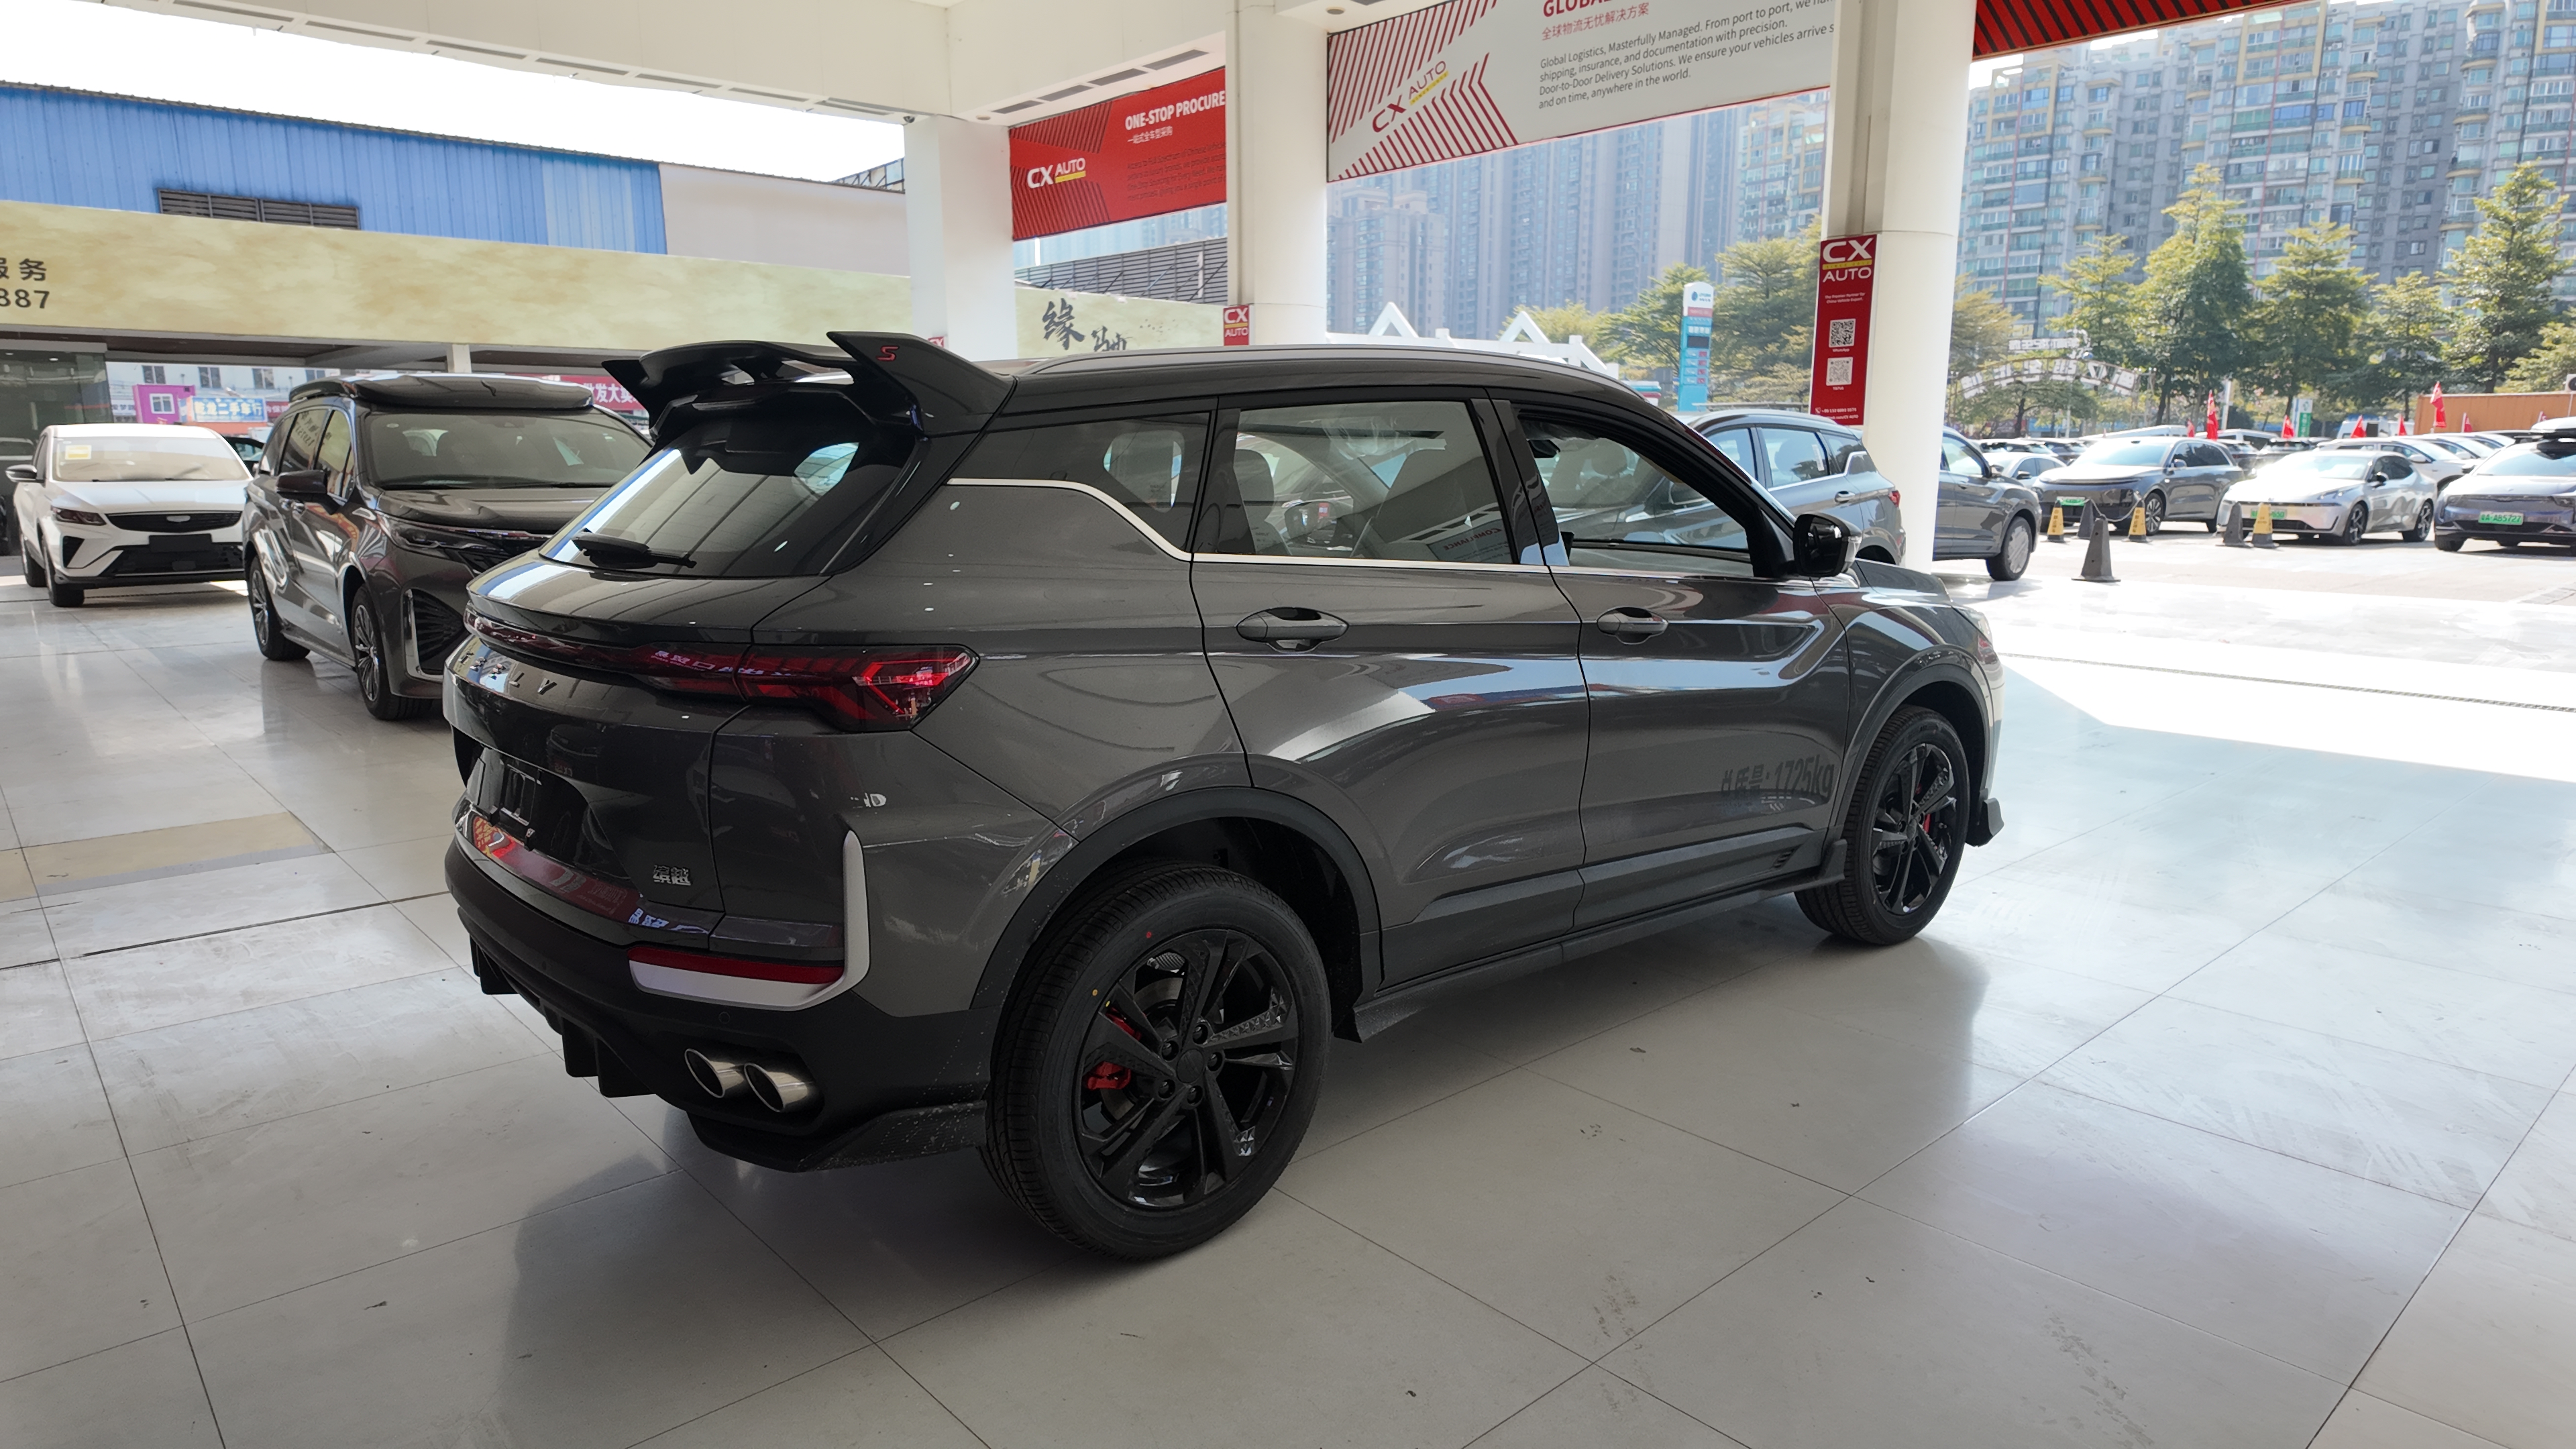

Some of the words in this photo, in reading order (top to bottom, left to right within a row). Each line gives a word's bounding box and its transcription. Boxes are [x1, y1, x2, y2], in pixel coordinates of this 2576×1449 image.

[1540, 53, 1566, 68] Global
[1568, 47, 1607, 62] Logistics,
[1609, 33, 1656, 52] Masterfully
[1658, 21, 1703, 41] Managed.
[1705, 17, 1730, 30] From
[1732, 11, 1753, 27] port
[1756, 9, 1766, 19] to
[1768, 2, 1793, 18] port,
[1796, 0, 1811, 9] we
[1542, 2, 1650, 41] 全球物流无忧解决方案
[1539, 76, 1593, 96] Door-to-Door
[1595, 68, 1629, 84] Delivery
[1631, 59, 1676, 76] Solutions.
[1678, 54, 1693, 65] We
[1695, 48, 1727, 62] ensure
[1729, 41, 1752, 58] your
[1753, 32, 1794, 49] vehicles
[1796, 25, 1827, 40] arrive
[1540, 67, 1577, 83] shipping,
[1578, 57, 1622, 73] insurance,
[1623, 50, 1641, 64] and
[1643, 36, 1713, 60] documentation
[1715, 28, 1737, 42] with
[1739, 19, 1788, 40] precision.
[1373, 95, 1407, 132] CX
[1409, 60, 1446, 99] AUTO
[1538, 97, 1554, 109] and
[1556, 96, 1566, 105] on
[1568, 92, 1590, 103] time,
[1591, 83, 1633, 99] anywhere
[1635, 78, 1644, 89] in
[1646, 75, 1660, 87] the
[1662, 67, 1691, 83] world.
[1125, 105, 1175, 130] ONE-STOP
[1175, 90, 1226, 117] PROCURE
[1027, 164, 1054, 189] CX
[1055, 158, 1086, 176] AUTO
[1823, 237, 1874, 262] CX
[1822, 267, 1872, 282] AUTO
[1224, 307, 1248, 323] CX
[1224, 327, 1248, 337] AUTO
[876, 345, 899, 361] S
